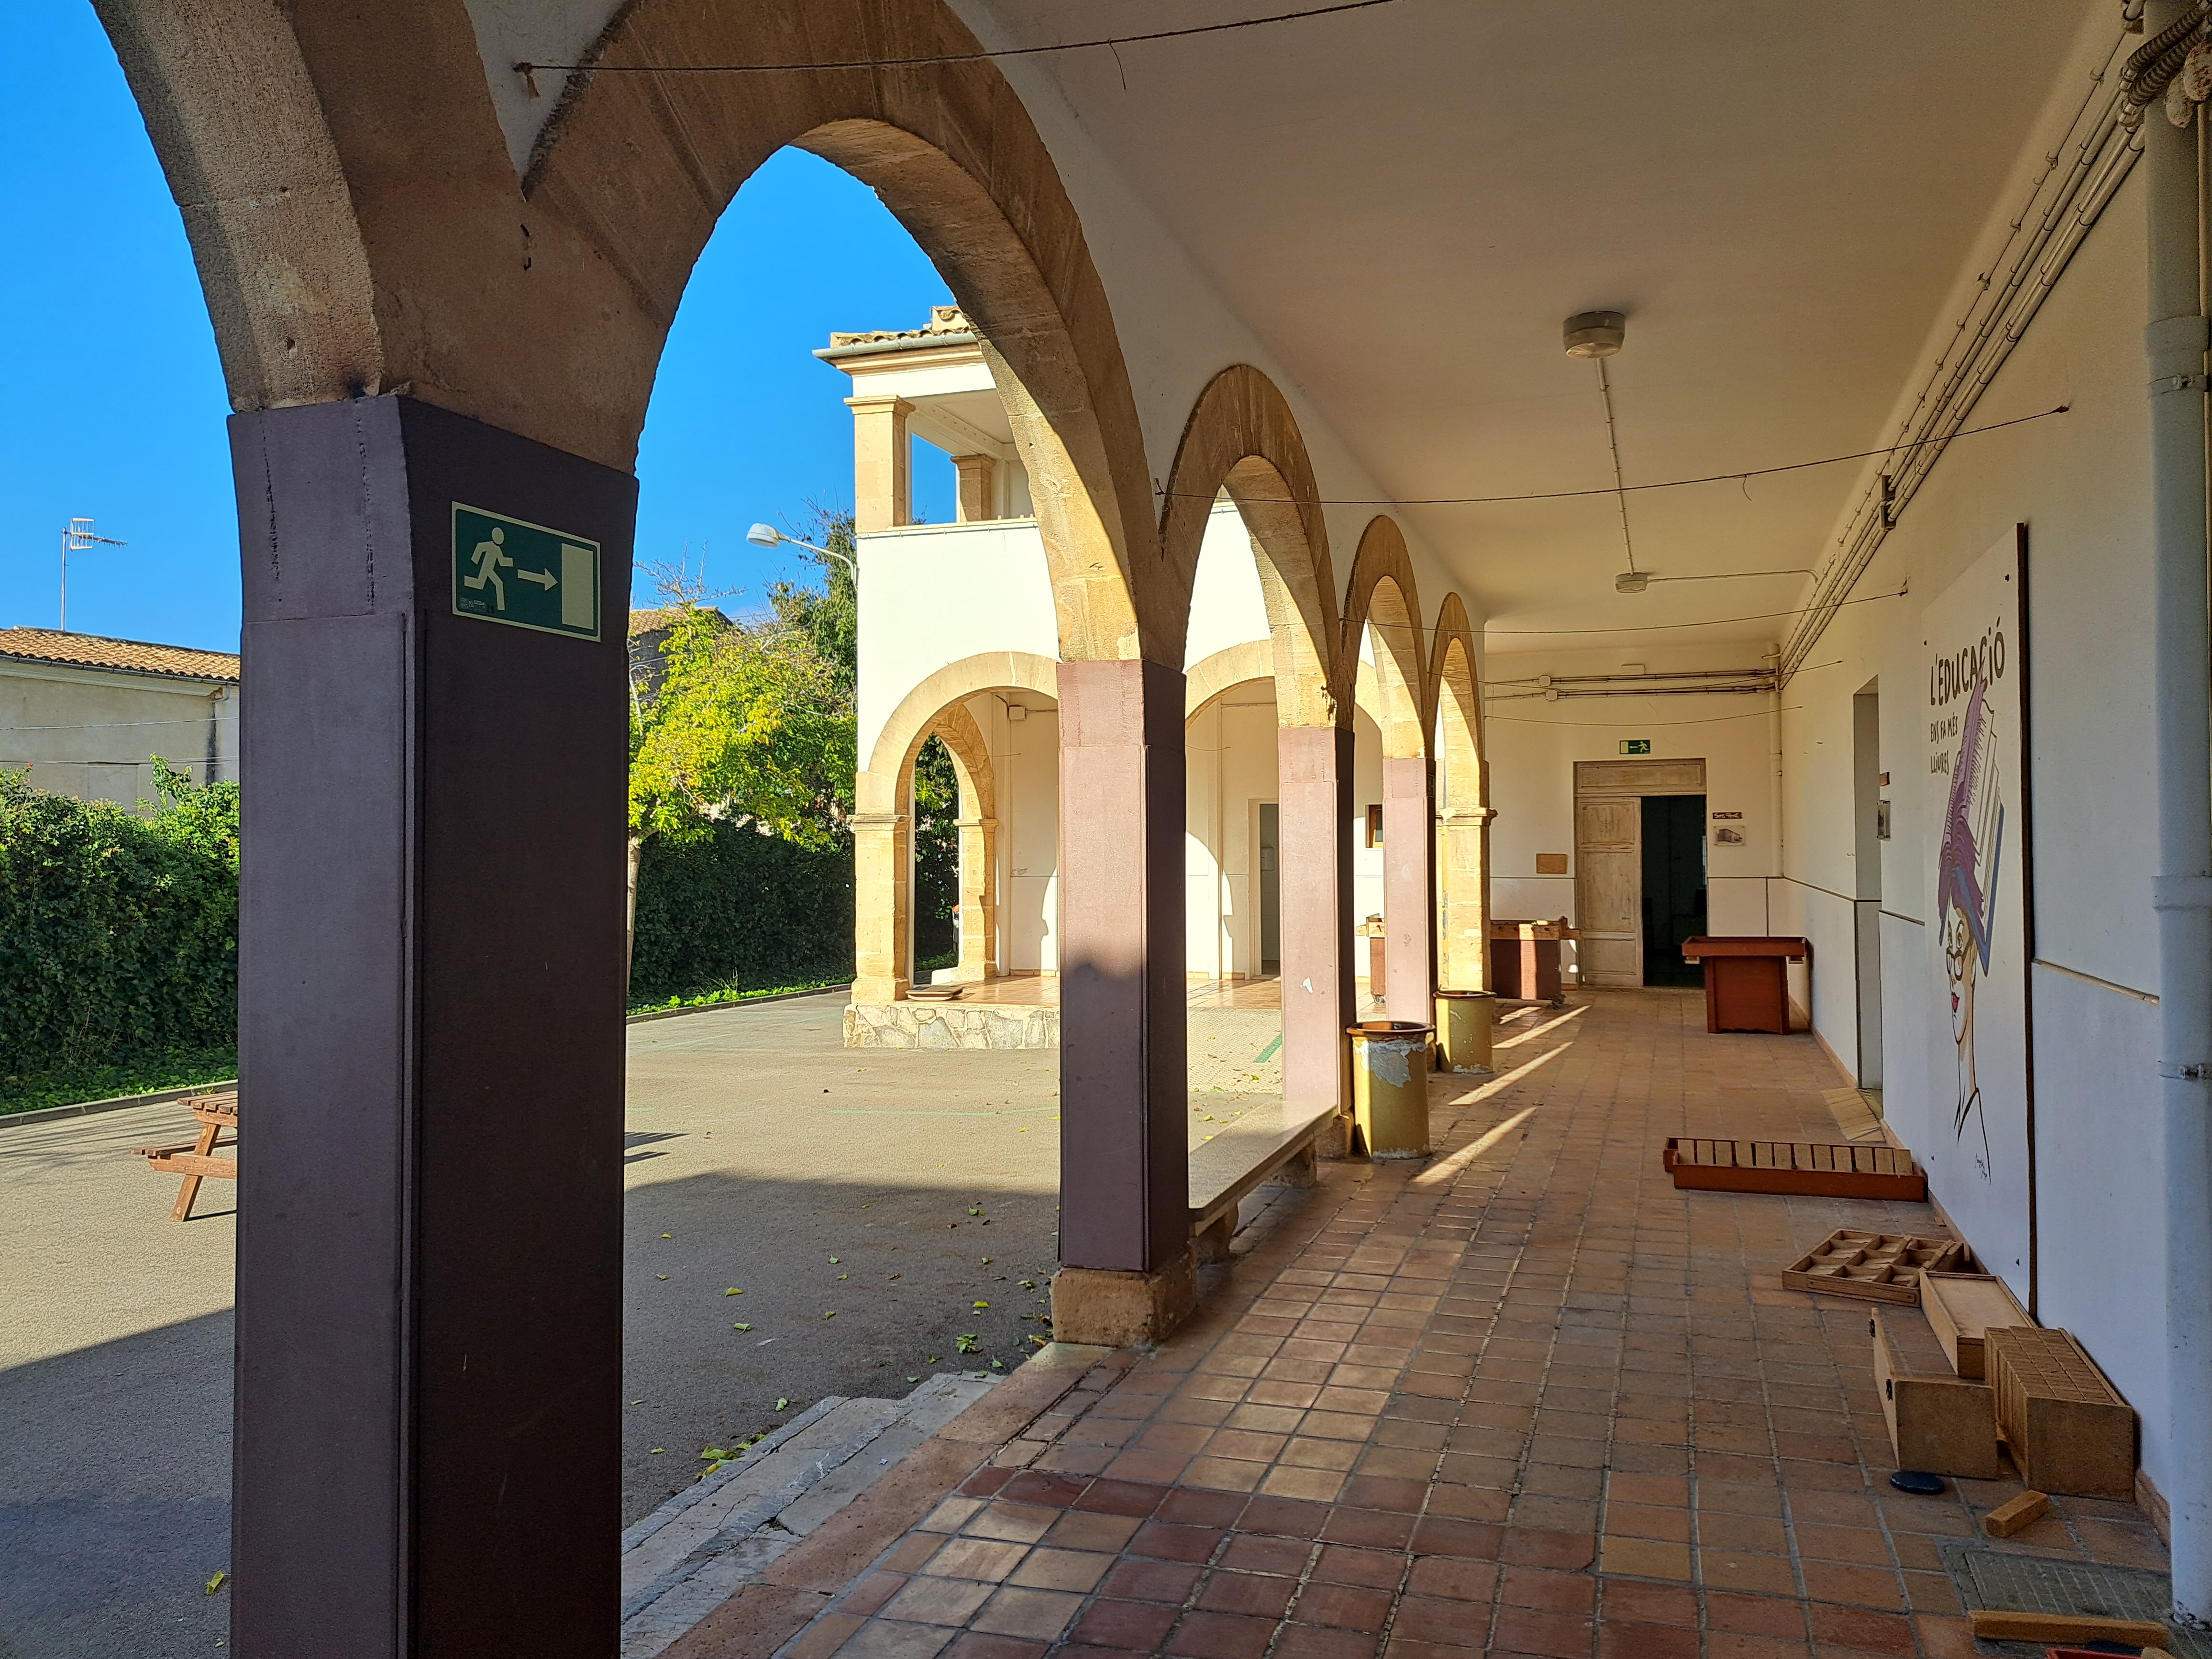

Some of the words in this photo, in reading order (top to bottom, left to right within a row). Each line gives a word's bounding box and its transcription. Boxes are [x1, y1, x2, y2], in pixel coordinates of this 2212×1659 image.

[1931, 720, 1939, 744] ENS
[1940, 720, 1946, 740] FA
[1947, 711, 1958, 738] MÉS
